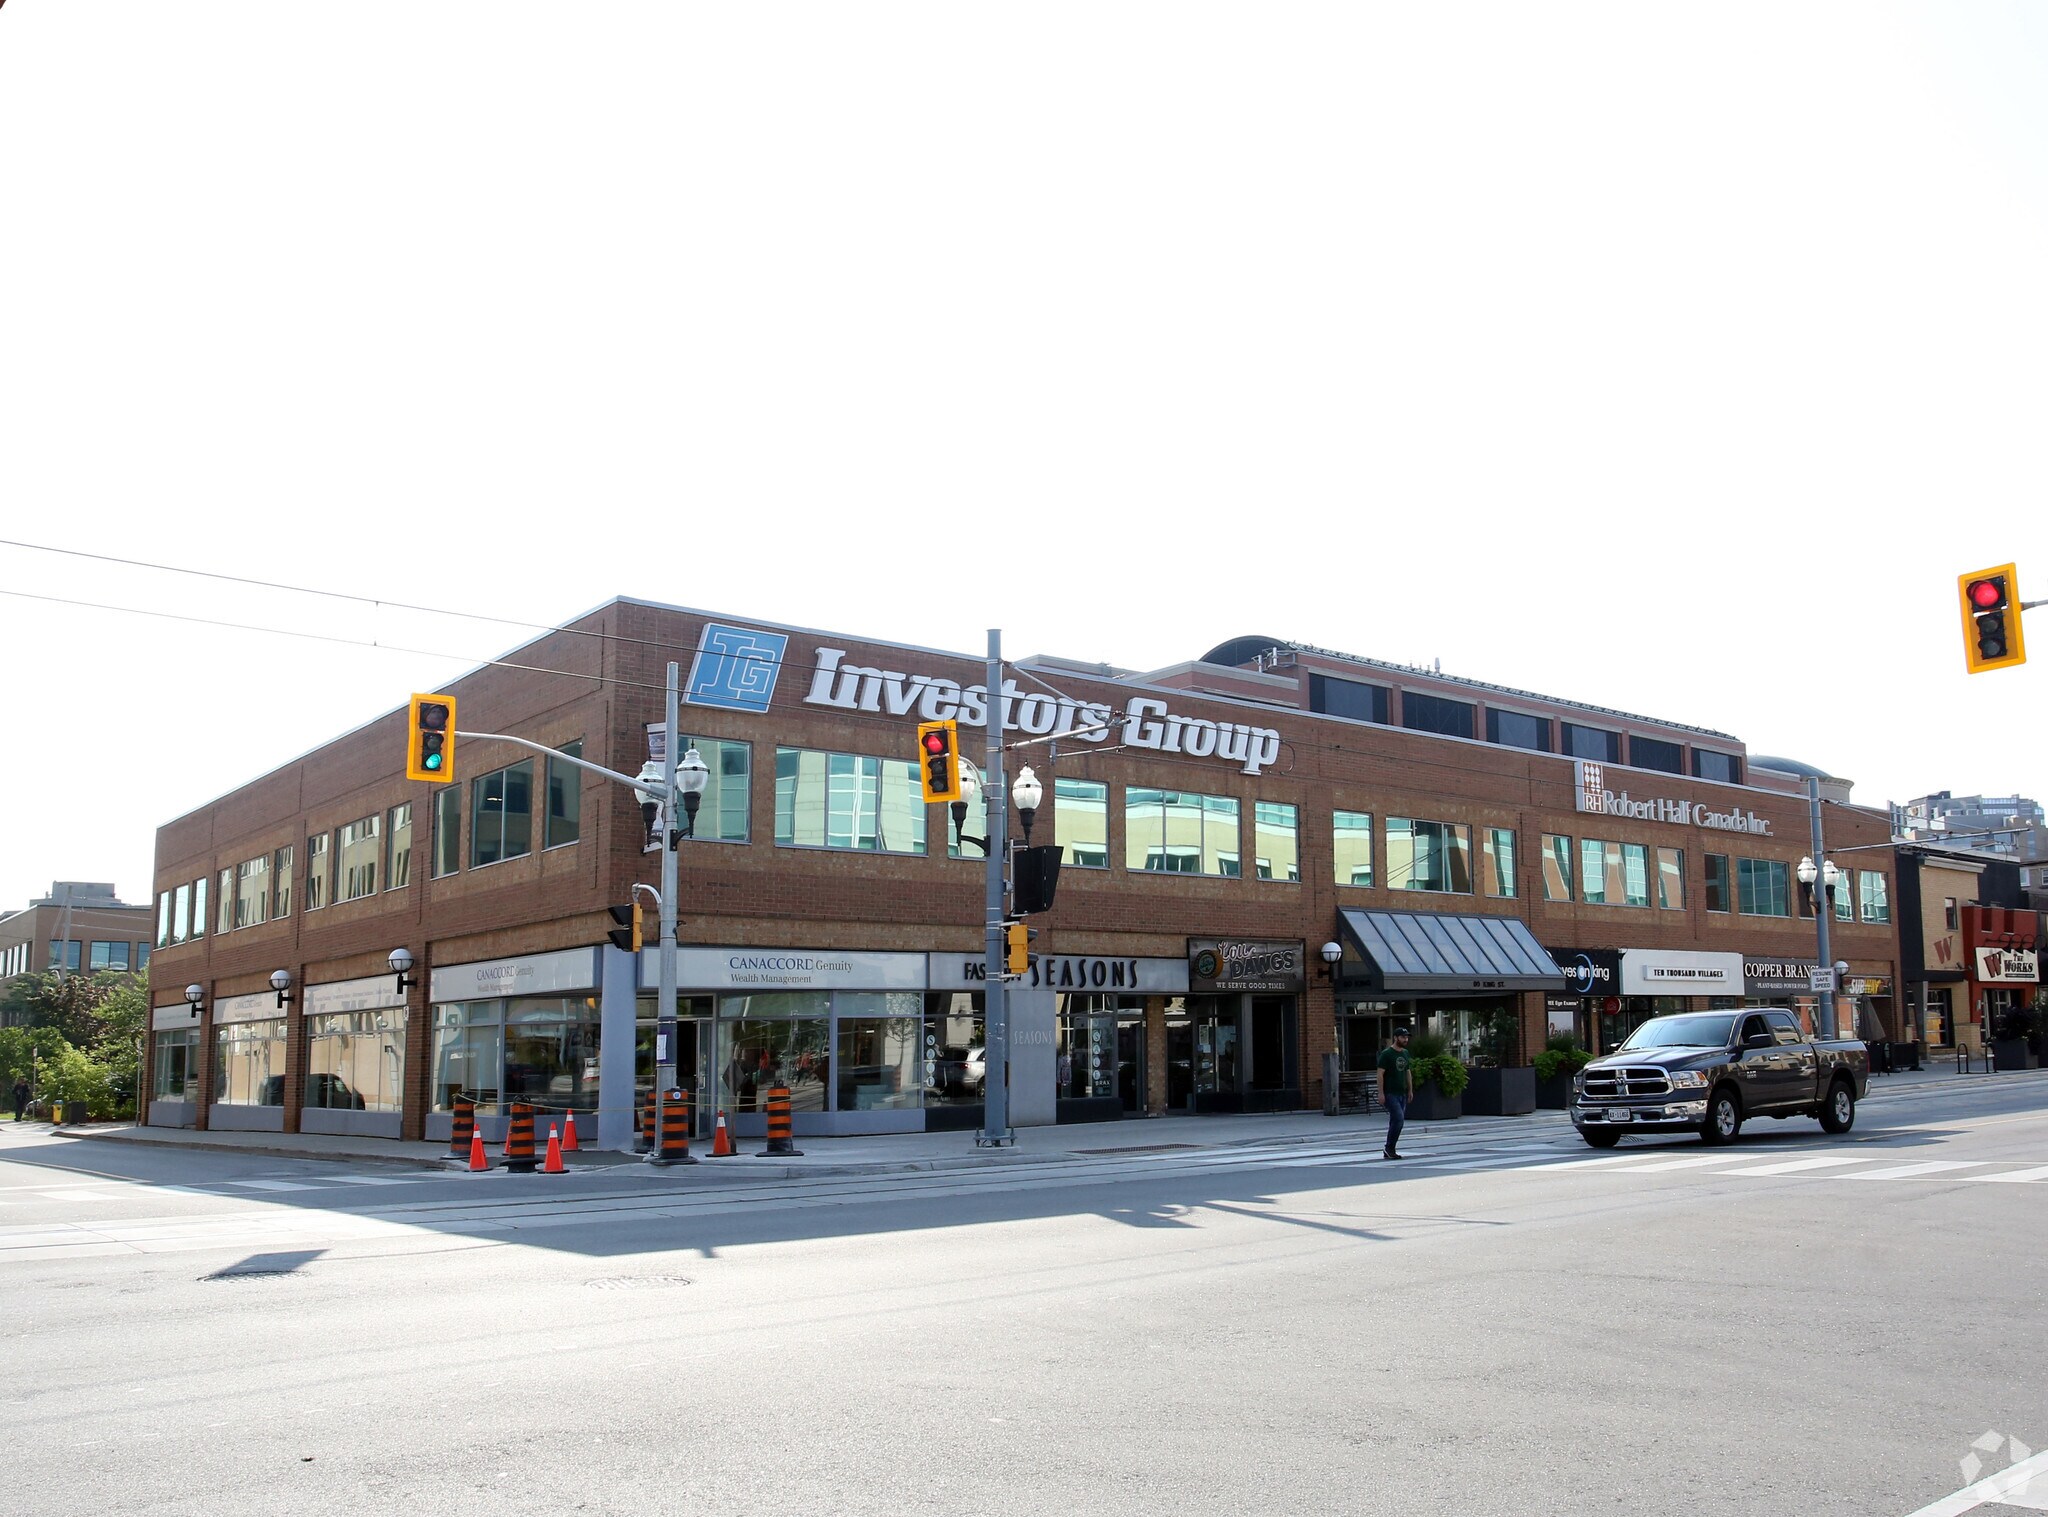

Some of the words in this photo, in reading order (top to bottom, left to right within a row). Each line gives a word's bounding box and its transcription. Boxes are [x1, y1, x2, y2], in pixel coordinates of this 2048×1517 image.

[802, 647, 1112, 743] Investors
[1120, 697, 1280, 776] Group
[1585, 795, 1601, 812] RH
[1603, 789, 1657, 821] Robert
[1657, 798, 1691, 824] Half
[1692, 803, 1748, 833] Canada
[729, 956, 814, 970] CANACCORD
[816, 960, 853, 972] Genuity
[1744, 962, 1784, 978] COPPER
[476, 966, 514, 980] CANACCORD
[731, 974, 758, 983] Wealth
[760, 974, 812, 984] Management
[1031, 958, 1138, 988] SEASONS
[1591, 965, 1610, 981] king
[1666, 969, 1696, 977] THOUSAND
[1698, 970, 1724, 978] VILLAGES
[1850, 978, 1882, 994] SUBWAY
[1014, 1030, 1052, 1045] SEASONS
